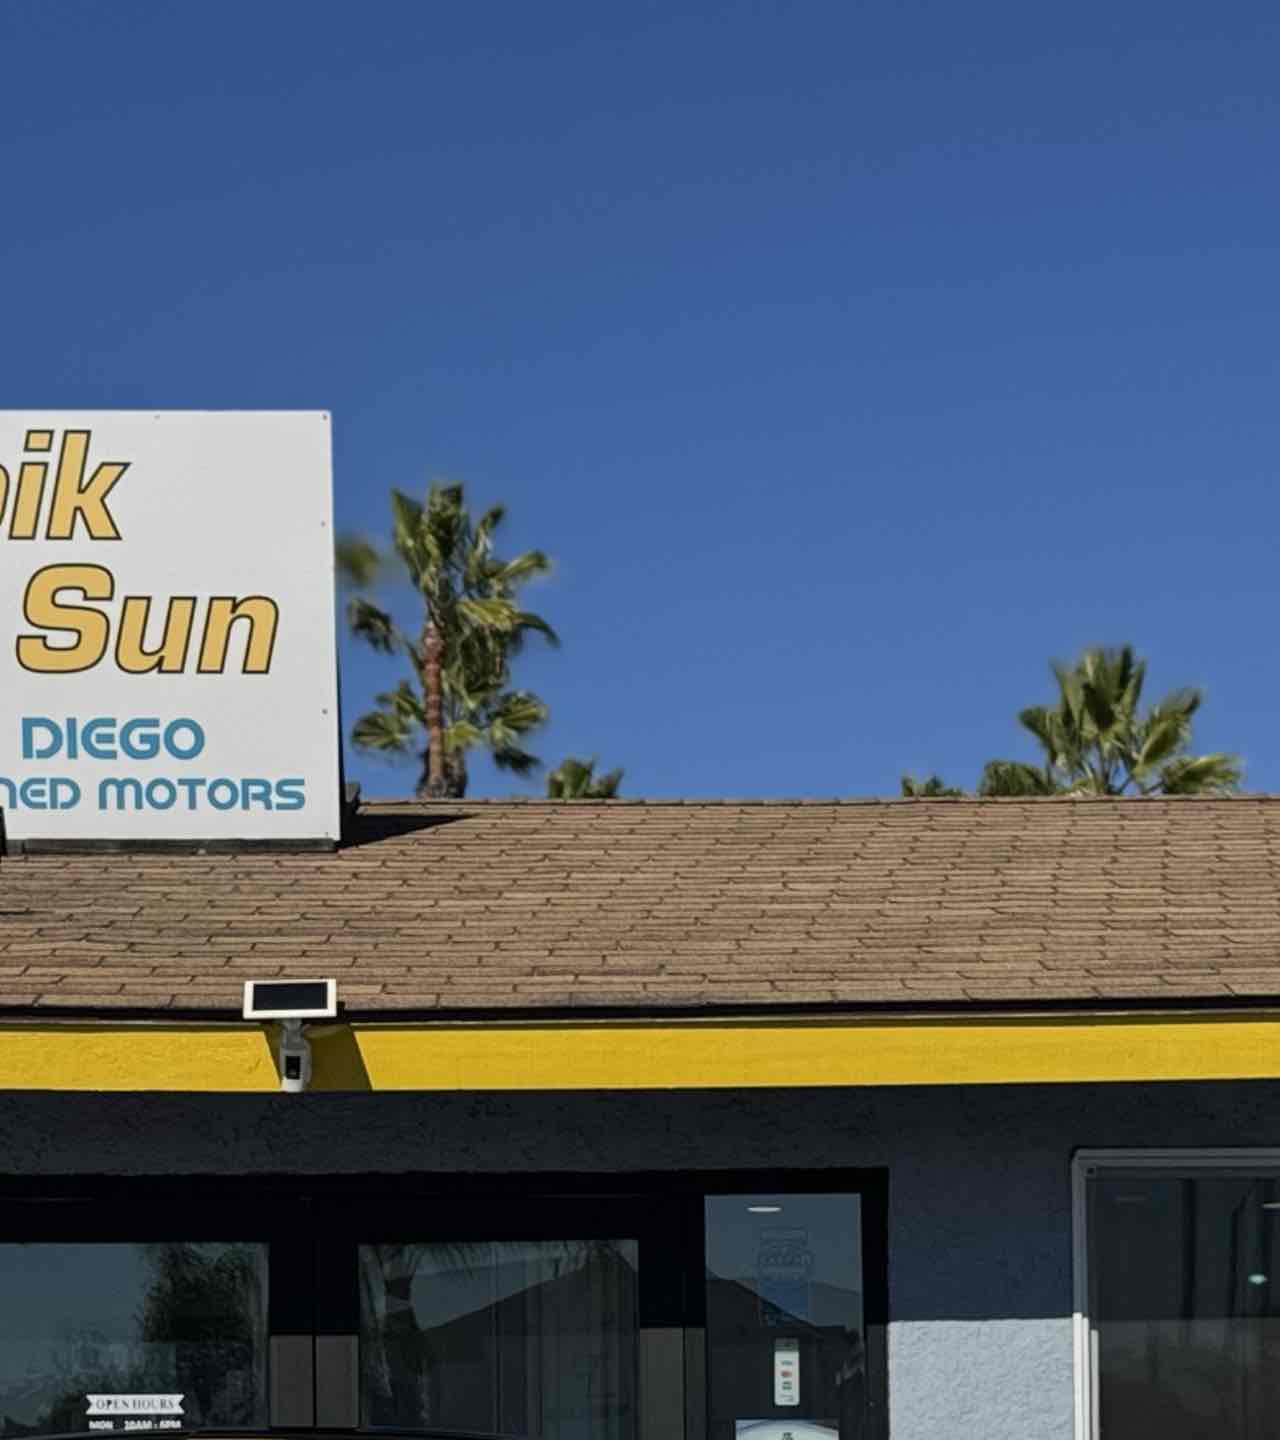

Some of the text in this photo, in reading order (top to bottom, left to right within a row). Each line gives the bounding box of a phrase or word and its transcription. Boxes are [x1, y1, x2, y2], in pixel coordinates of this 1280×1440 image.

[16, 563, 279, 674] Sun
[21, 717, 206, 761] DIEGO
[98, 777, 306, 812] MOTORS
[96, 1398, 175, 1410] OPEN HOURS
